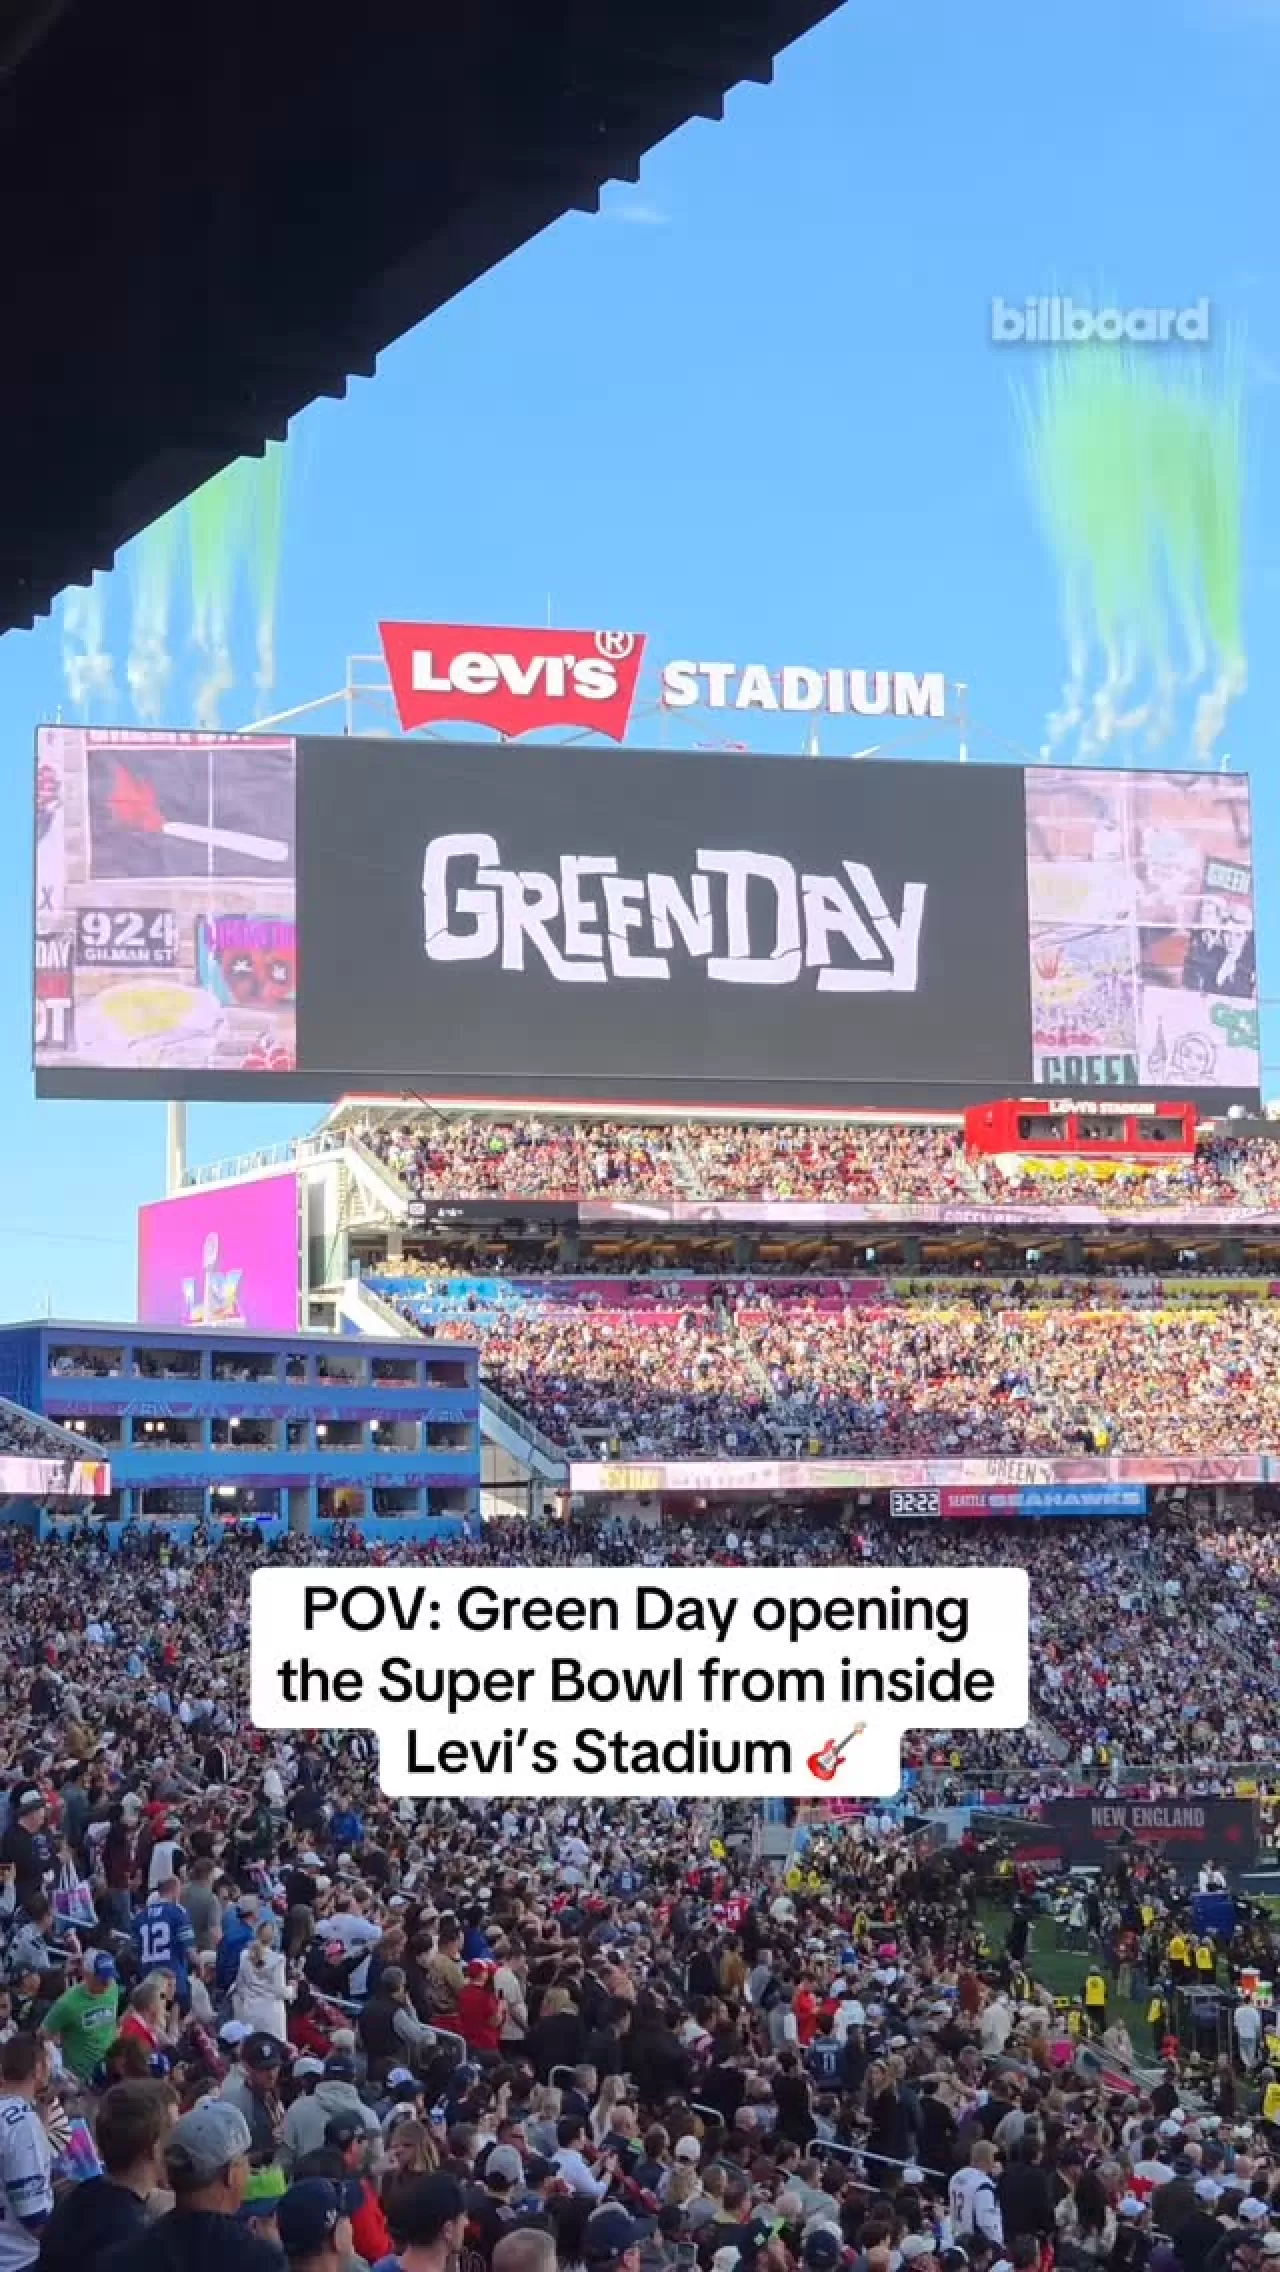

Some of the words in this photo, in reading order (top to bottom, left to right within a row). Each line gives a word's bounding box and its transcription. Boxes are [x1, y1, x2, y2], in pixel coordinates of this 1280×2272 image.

[661, 660, 946, 717] STADIUM
[81, 911, 174, 947] 924
[85, 949, 149, 961] GILMAN
[154, 949, 173, 962] ST
[1091, 1807, 1126, 1828] NEW
[1131, 1807, 1205, 1828] ENGLAND
[140, 1921, 170, 1963] 12
